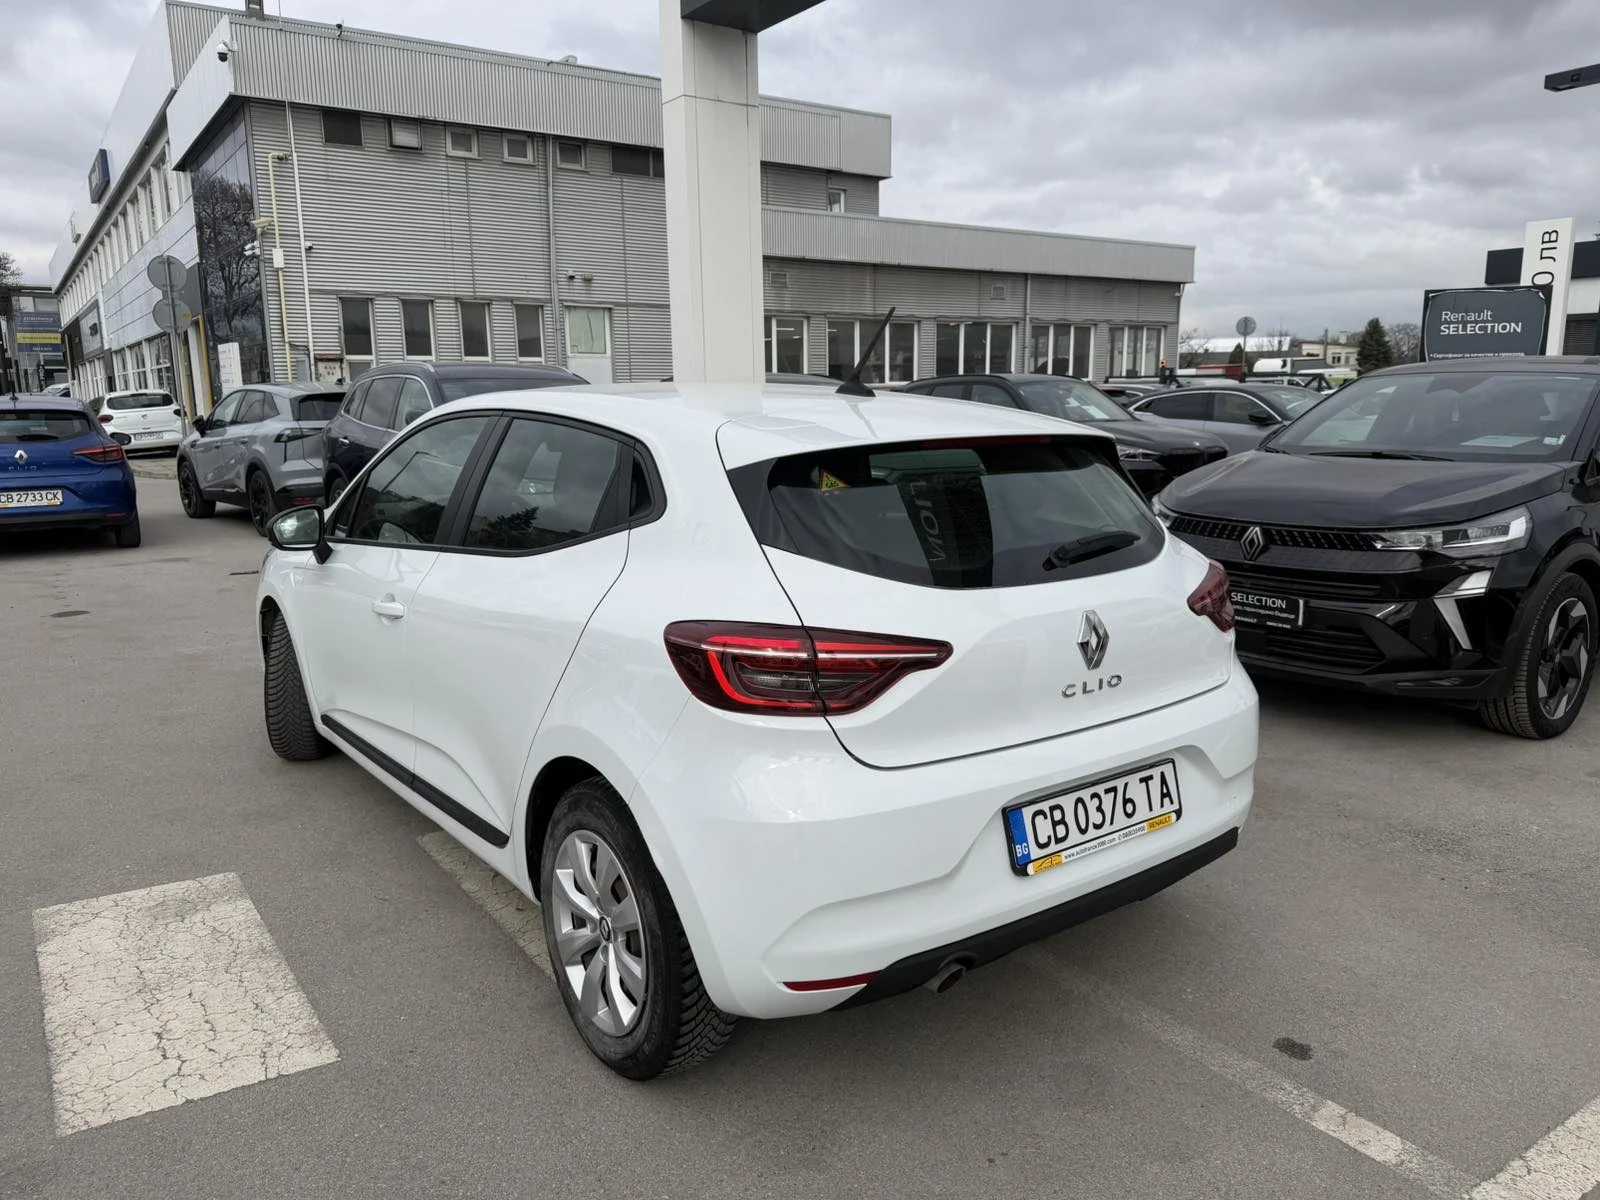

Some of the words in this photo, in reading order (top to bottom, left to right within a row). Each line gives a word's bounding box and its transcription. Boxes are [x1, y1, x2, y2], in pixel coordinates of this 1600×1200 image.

[1441, 309, 1493, 322] Renault
[1440, 322, 1522, 335] SELECTION
[16, 492, 43, 502] 2733
[45, 491, 60, 501] CK
[1231, 592, 1286, 608] SELECTION
[1061, 674, 1122, 698] CLIO
[1016, 842, 1029, 857] BG
[1031, 803, 1070, 849] CB
[1074, 782, 1137, 835] 0376
[1139, 771, 1174, 812] TA
[1149, 816, 1172, 829] RENAULT
